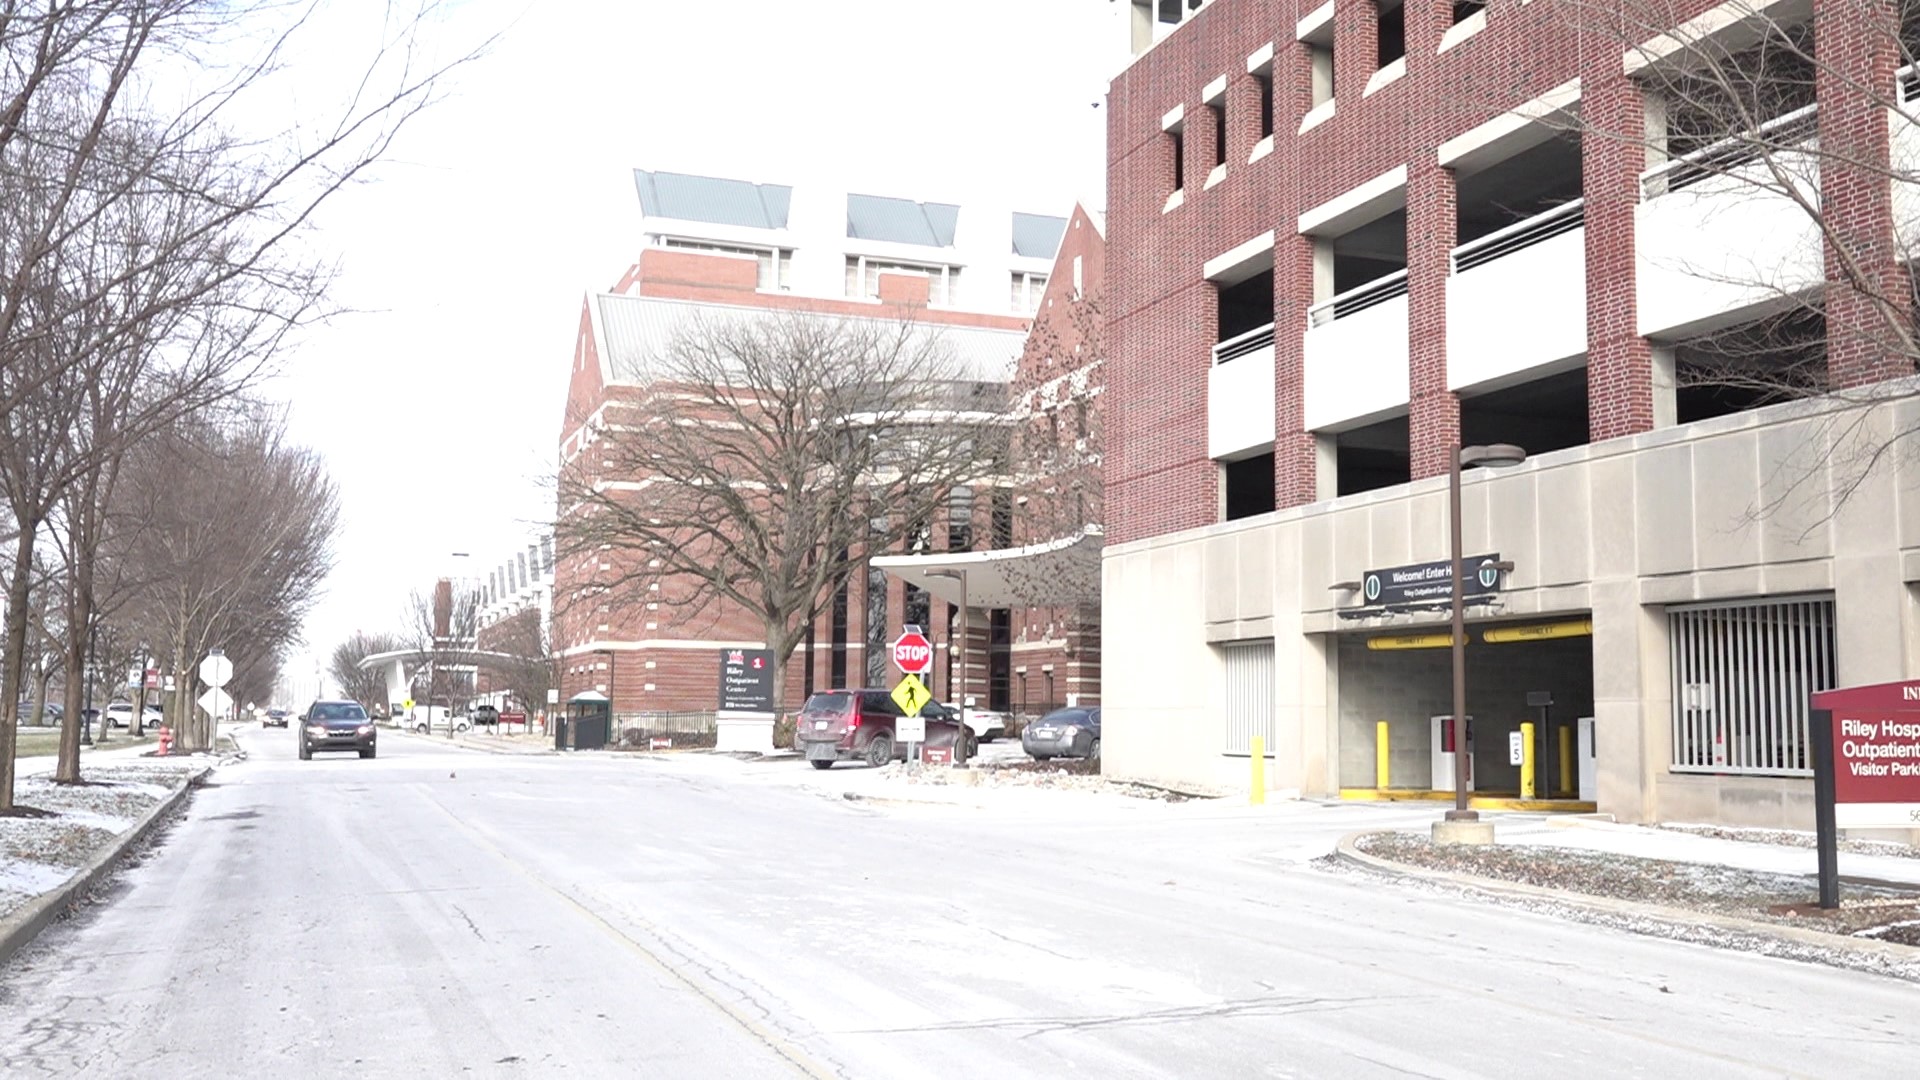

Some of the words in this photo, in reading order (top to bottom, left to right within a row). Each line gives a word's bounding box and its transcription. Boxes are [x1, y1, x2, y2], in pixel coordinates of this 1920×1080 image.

[1393, 569, 1425, 583] Welcome!
[1426, 567, 1445, 579] Enter
[896, 645, 929, 661] STOP
[753, 657, 762, 669] 1
[727, 667, 743, 676] Riley
[726, 676, 759, 685] Outpatient
[726, 685, 747, 693] Center
[1903, 686, 1920, 701] IN
[1841, 719, 1878, 741] Riley
[1881, 719, 1920, 741] Hosp
[1514, 748, 1519, 761] 5
[1842, 740, 1920, 761] Outpatient
[1849, 762, 1889, 776] Visitor
